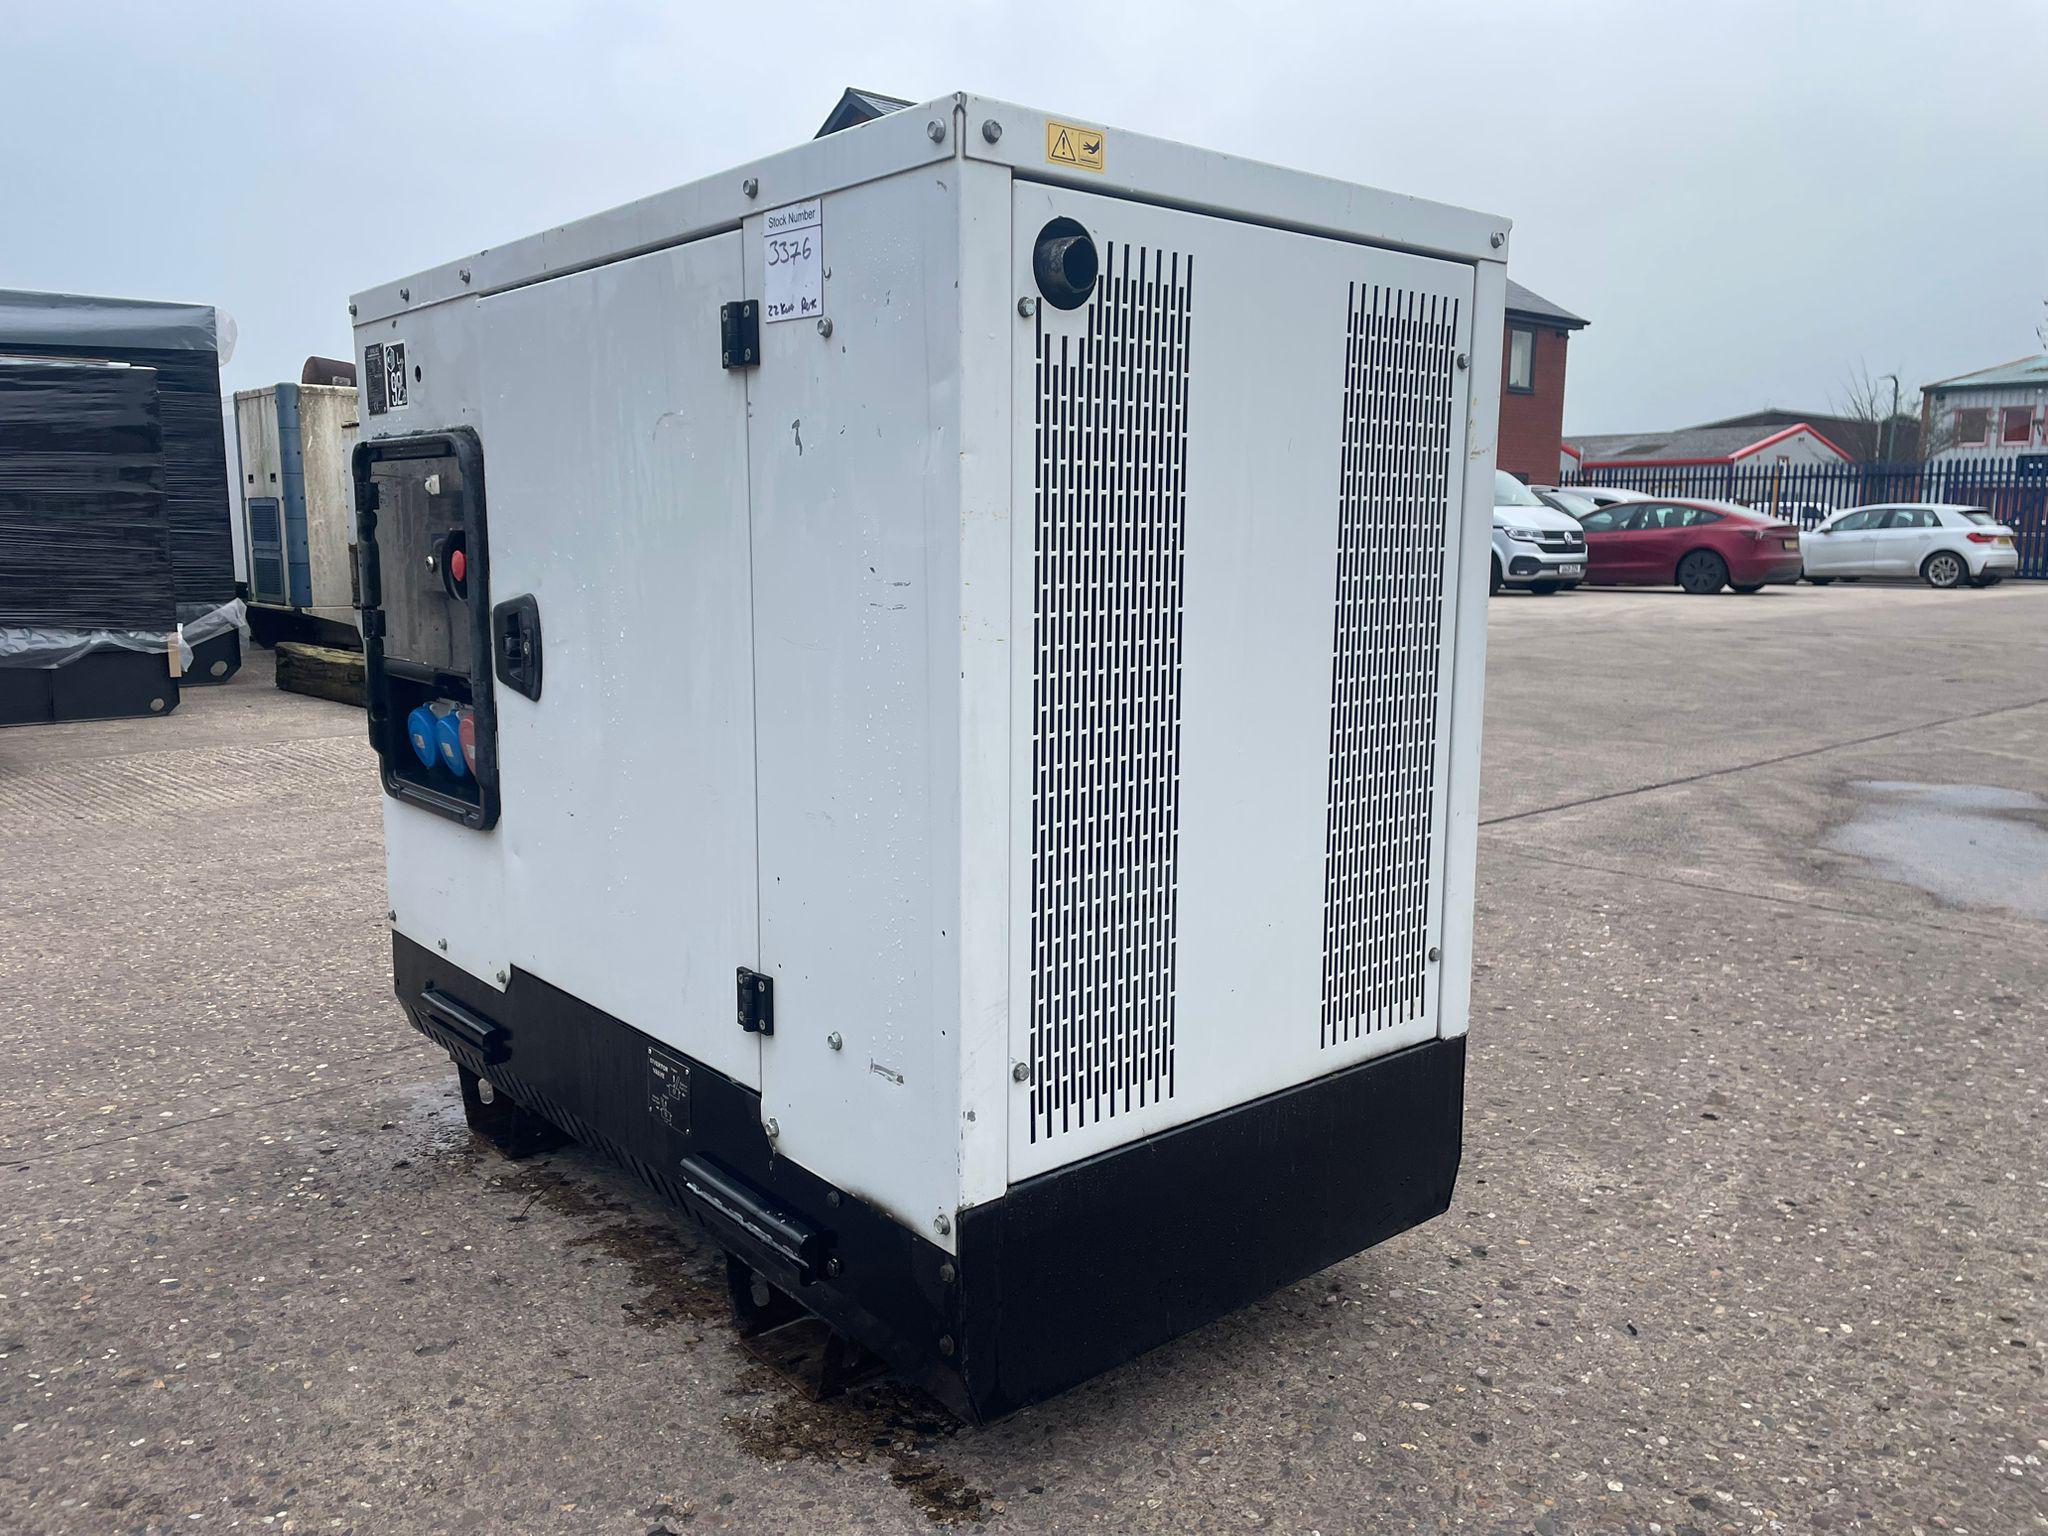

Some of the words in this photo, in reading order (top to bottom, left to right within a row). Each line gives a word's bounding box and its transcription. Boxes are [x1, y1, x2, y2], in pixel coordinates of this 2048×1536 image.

[768, 214, 787, 229] Stock
[788, 208, 816, 224] Number
[768, 236, 812, 266] 3376
